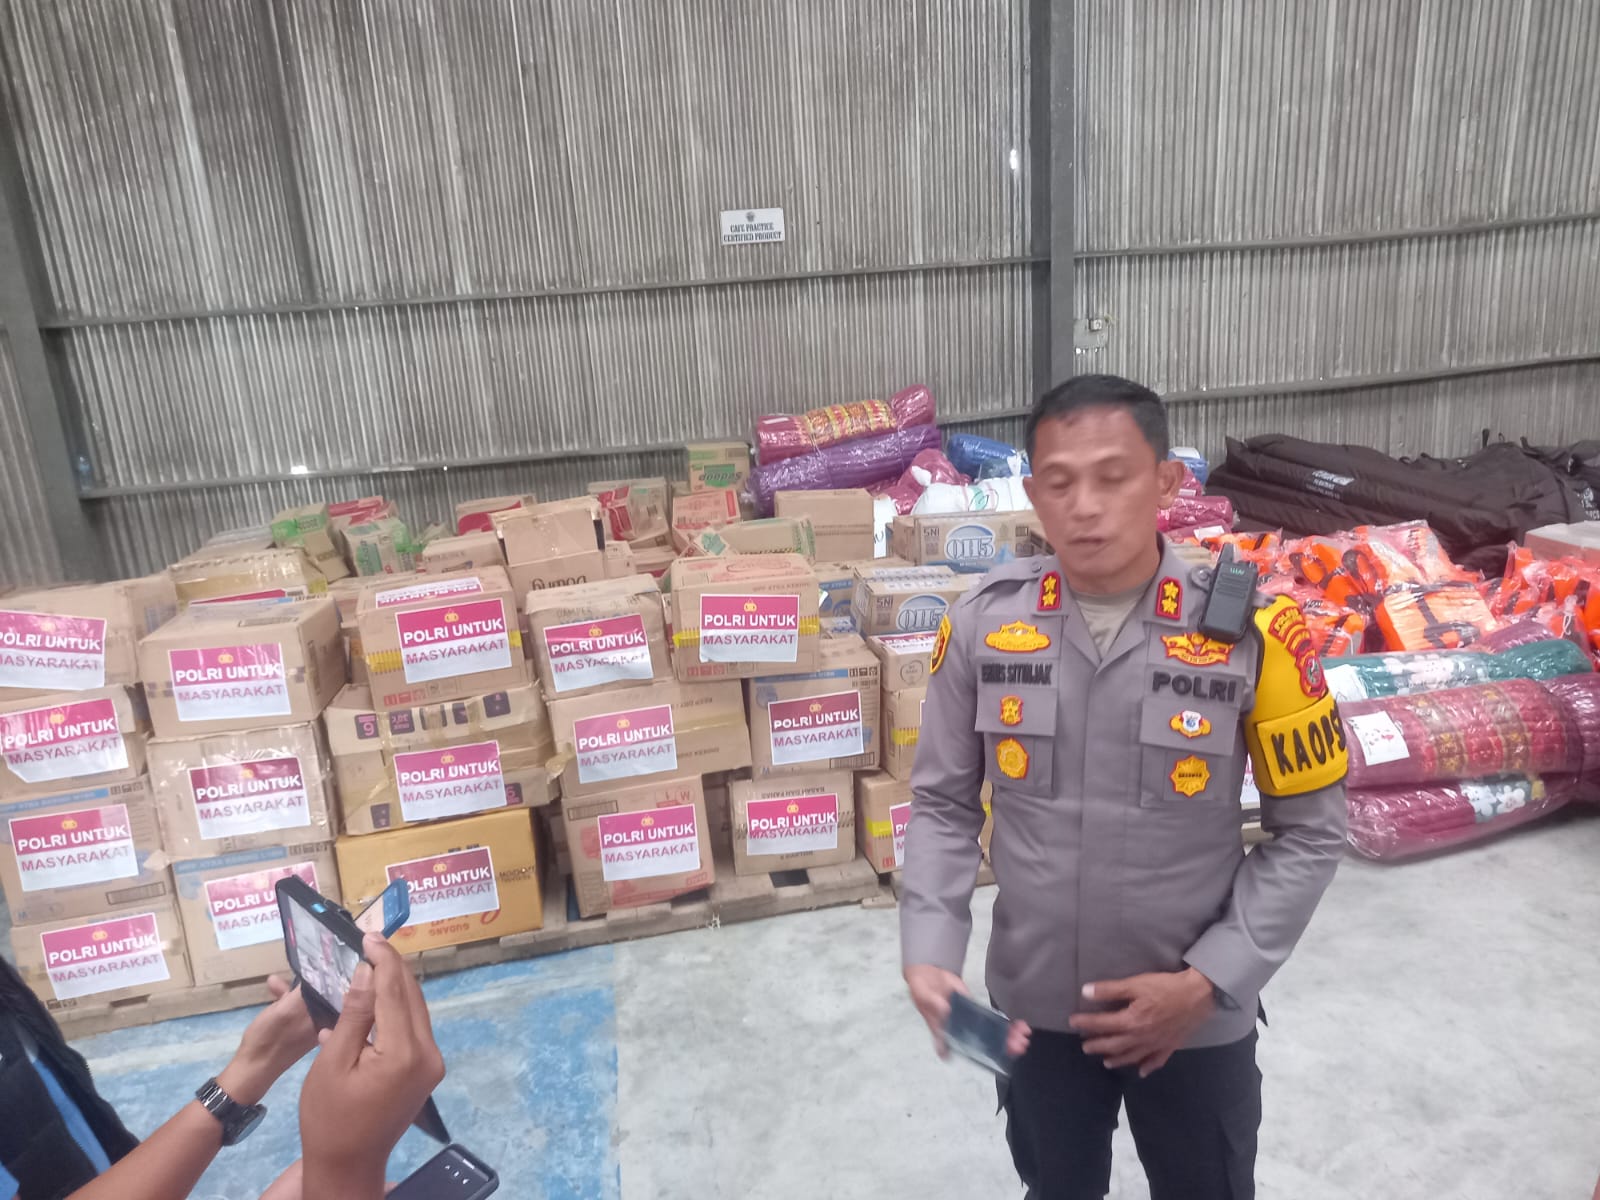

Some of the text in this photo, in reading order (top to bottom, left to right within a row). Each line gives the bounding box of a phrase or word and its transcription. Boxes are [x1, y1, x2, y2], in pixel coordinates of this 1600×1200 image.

[723, 231, 782, 243] CERTIFIED PRODUCT
[746, 222, 775, 232] PRACTICE
[923, 526, 940, 537] SNI
[876, 595, 894, 609] SNI
[403, 617, 503, 645] POLRI UNTUK
[704, 614, 796, 626] POLRI UNTUK
[45, 633, 101, 650] UNTUK
[405, 638, 506, 665] MASYARAKAT
[551, 631, 644, 656] POLRI UNTUK
[703, 634, 795, 645] MASYARAKAT
[175, 663, 282, 683] POLRI UNTUK
[177, 684, 284, 702] MASYARAKAT
[1151, 671, 1237, 703] POLRI
[774, 708, 859, 730] POLRI UNTUK
[4, 717, 115, 749] POLRI UNTUK
[578, 723, 671, 750] POLRI UNTUK
[773, 727, 859, 748] MASYARAKAT
[1271, 703, 1347, 777] KAOPS
[8, 737, 120, 765] MASYARAKAT
[580, 743, 673, 767] MASYARAKAT
[400, 760, 499, 784] POLRI UNTUK
[196, 774, 301, 801] POLRI UNTUK
[402, 780, 500, 803] MASYARAKAT
[200, 795, 304, 820] MASYARAKAT
[750, 824, 834, 840] MASYARAKAT
[751, 811, 836, 831] POLRI UNTUK
[17, 824, 127, 851] POLRI UNTUK
[604, 822, 694, 846] POLRI UNTUK
[21, 844, 130, 872] MASYARAKAT
[604, 841, 695, 864] MASYARAKAT
[406, 878, 438, 895] OLRI
[440, 866, 491, 886] UNTUK
[213, 892, 261, 913] POLRI
[409, 881, 493, 906] ASYARAKAT
[218, 909, 281, 932] MASYAR
[428, 923, 470, 937] GUDANG
[49, 933, 158, 965] POLRI UNTUK
[53, 953, 160, 983] MASYARAKAT
